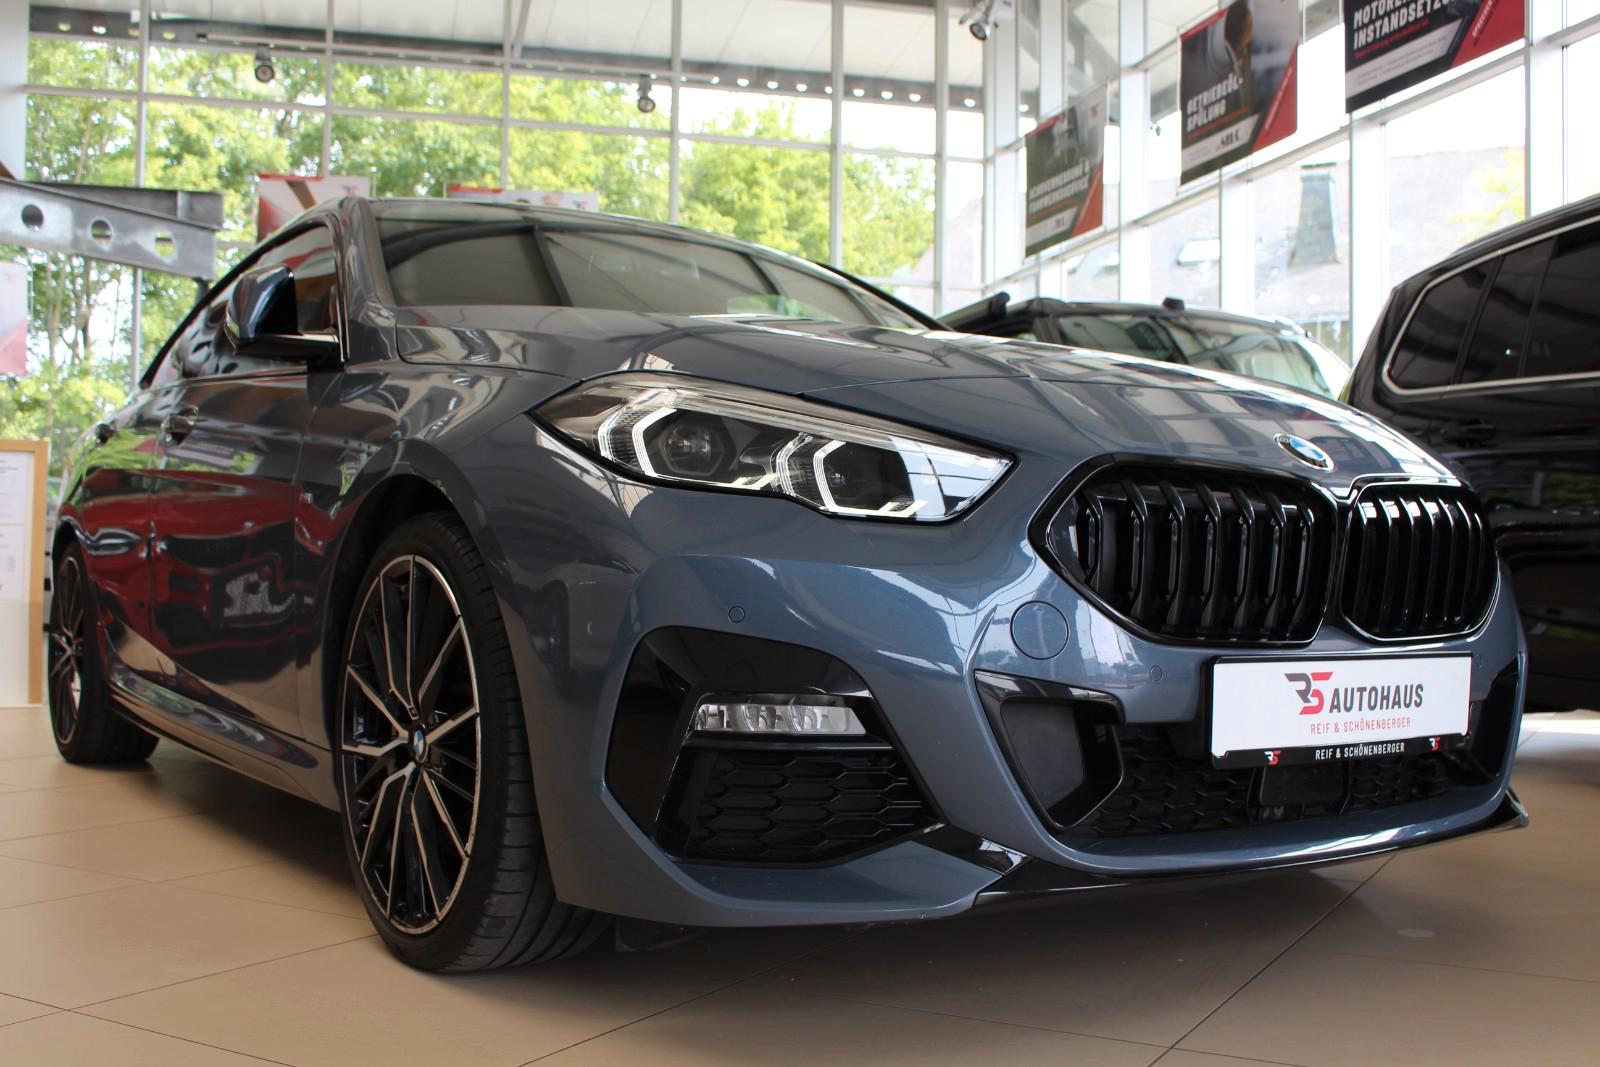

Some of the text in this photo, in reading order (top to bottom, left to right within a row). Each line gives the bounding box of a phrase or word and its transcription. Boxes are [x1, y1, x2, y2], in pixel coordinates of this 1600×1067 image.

[1329, 683, 1424, 714] AUTOHAUS
[1310, 717, 1412, 735] REIF & SCHÖNENBERGER
[1315, 749, 1333, 761] REIF
[1336, 748, 1342, 759] &
[1344, 742, 1405, 758] SCHÖNENBERGER
